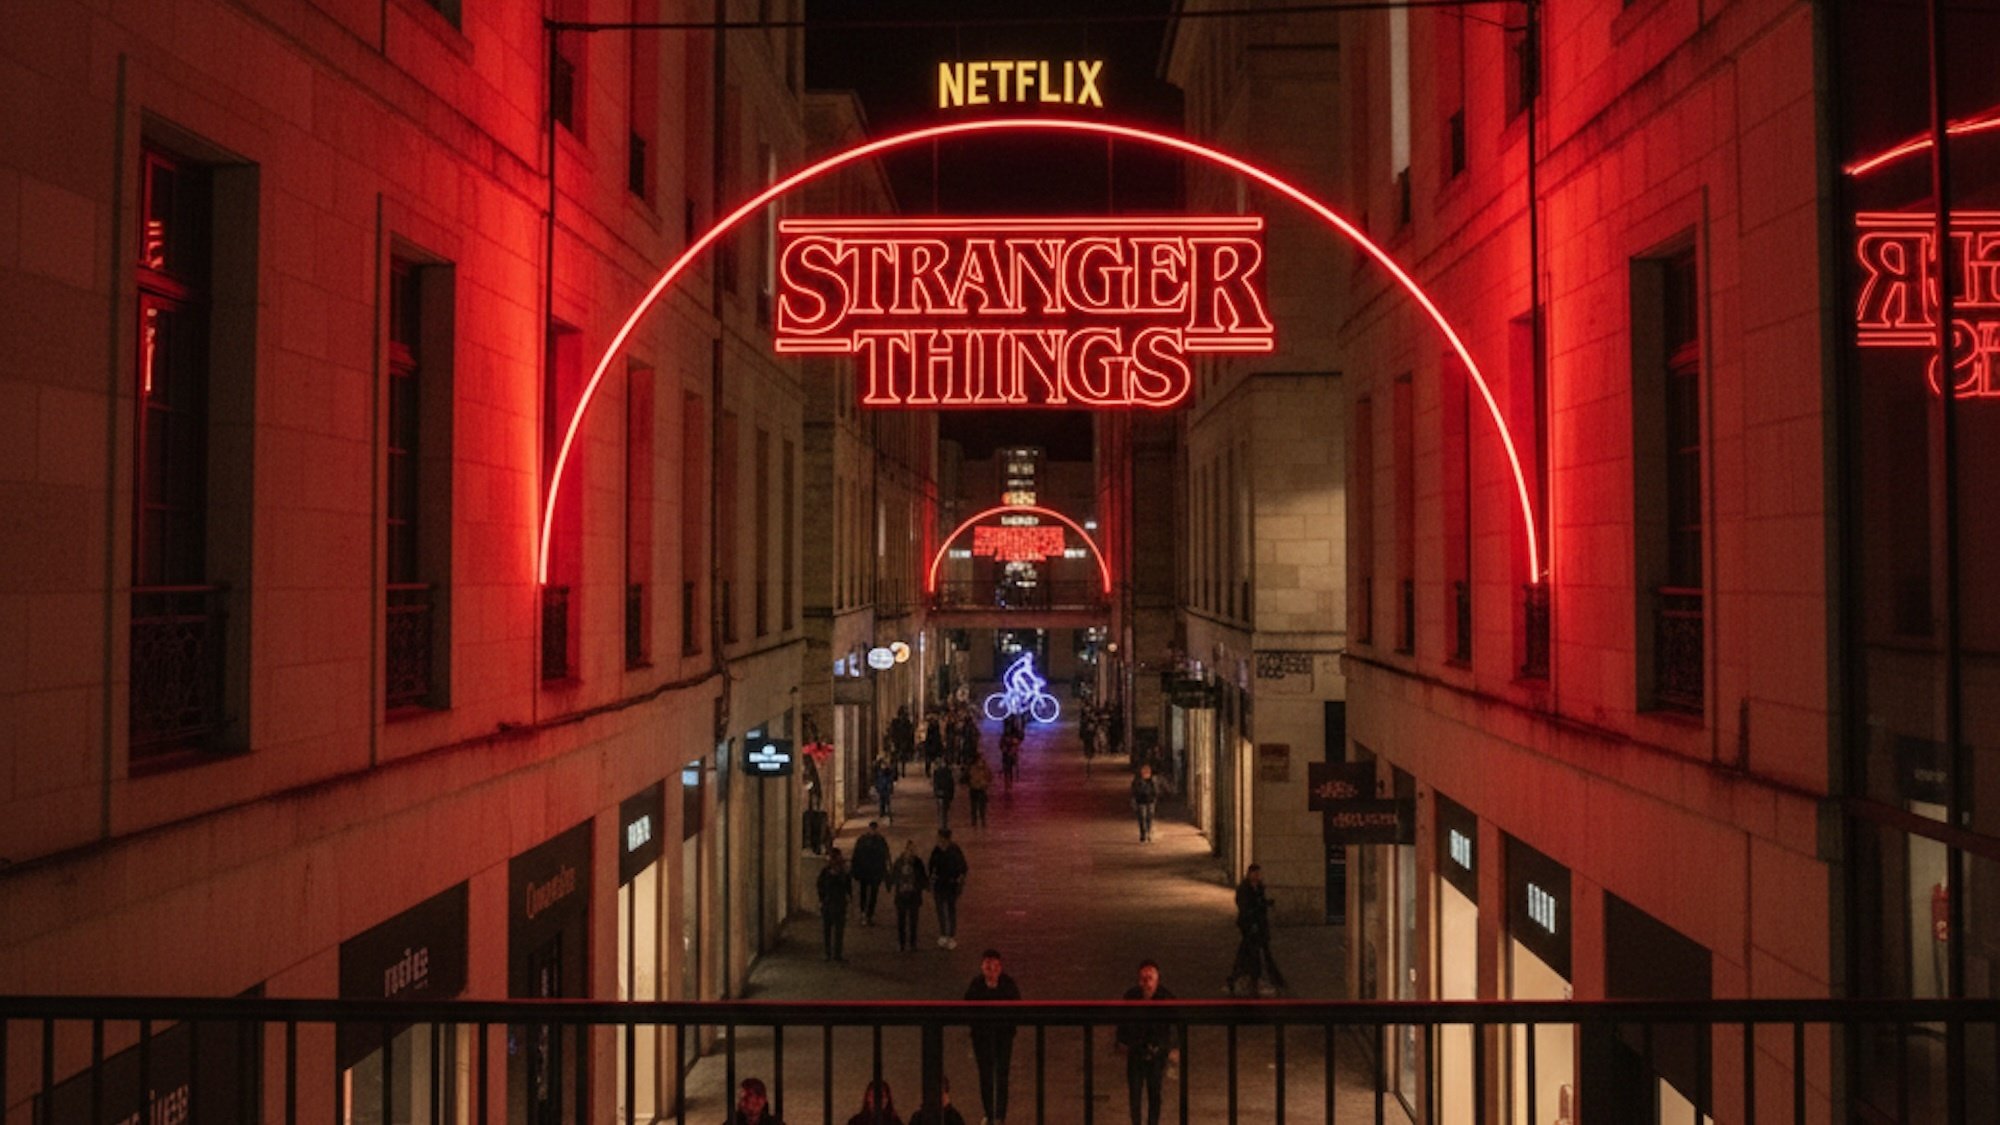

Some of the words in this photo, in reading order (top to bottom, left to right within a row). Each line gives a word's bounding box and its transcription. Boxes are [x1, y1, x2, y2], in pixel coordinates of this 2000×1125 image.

[937, 60, 1104, 108] NETFLIX
[777, 235, 1274, 335] STRANGER
[852, 326, 1192, 407] THINGS
